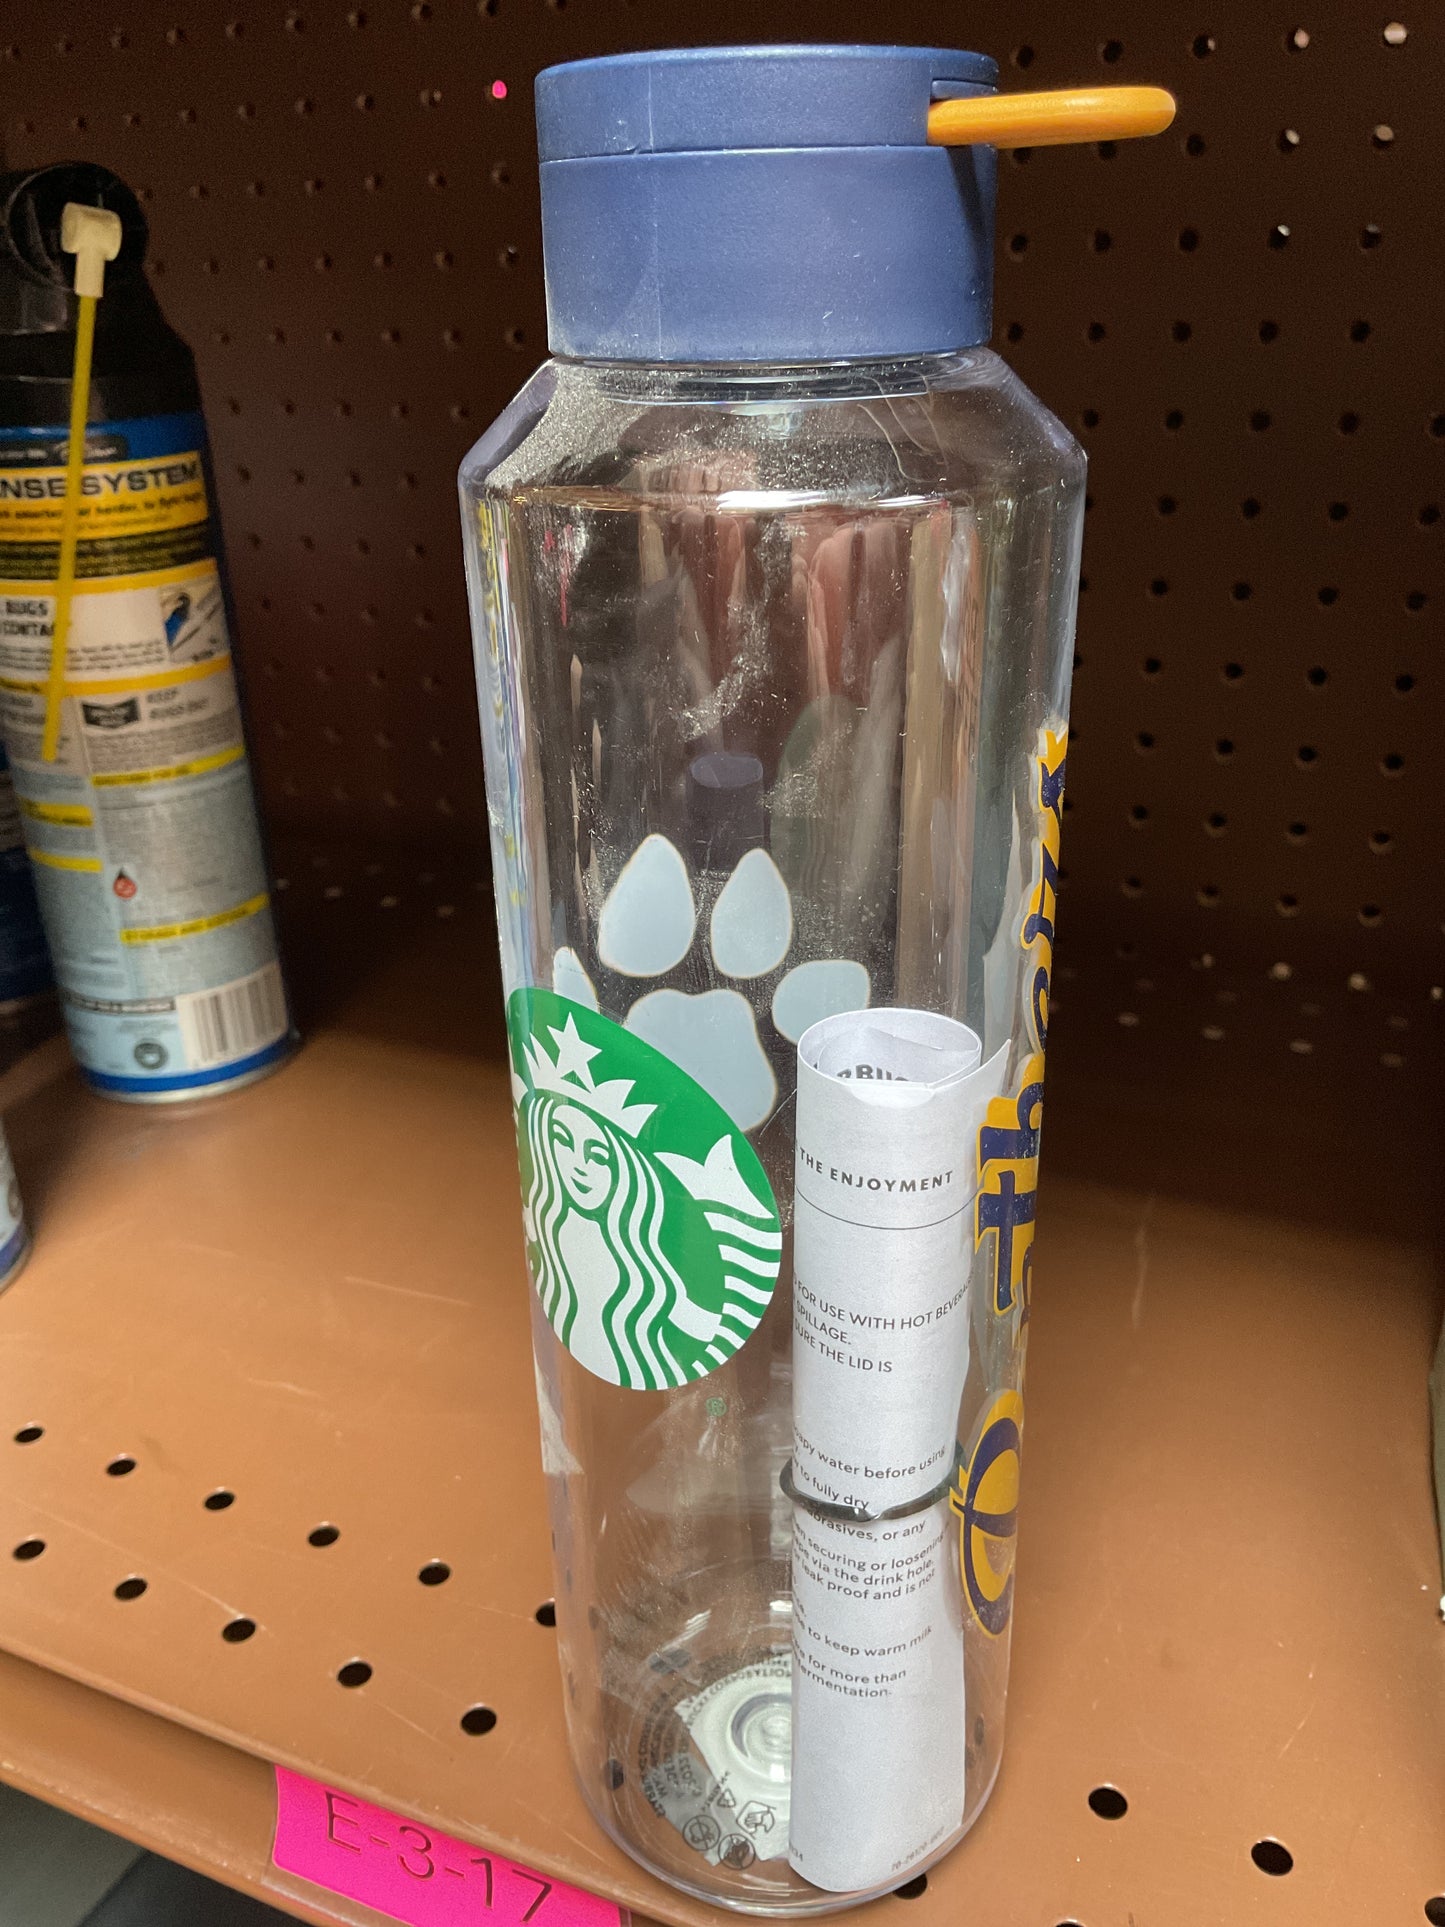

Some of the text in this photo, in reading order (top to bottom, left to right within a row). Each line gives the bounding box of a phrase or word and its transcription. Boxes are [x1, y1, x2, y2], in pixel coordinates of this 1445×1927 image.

[81, 459, 199, 496] SYSTEM
[800, 1147, 954, 1193] THE ENJOYMENT
[796, 1299, 852, 1346] SPILLAGE.
[797, 1280, 816, 1307] FOR
[819, 1299, 846, 1322] USE
[849, 1311, 896, 1331] WITH
[900, 1311, 933, 1331] HOT
[818, 1341, 845, 1365] THE
[848, 1355, 874, 1371] LID
[878, 1360, 893, 1373] IS
[818, 1451, 861, 1475] water
[864, 1464, 916, 1479] before
[919, 1445, 946, 1471] using
[812, 1476, 840, 1502] fully
[843, 1495, 870, 1511] dry
[882, 1530, 898, 1541] or
[902, 1519, 926, 1538] any
[808, 1537, 867, 1572] securing
[870, 1560, 886, 1571] or
[891, 1532, 945, 1570] loosening
[801, 1559, 937, 1600] leak proof and is not
[811, 1555, 934, 1586] via the drink hole.
[808, 1626, 821, 1641] to
[824, 1634, 860, 1657] keep
[864, 1643, 906, 1657] warm
[909, 1625, 932, 1647] milk
[808, 1654, 826, 1671] for
[830, 1668, 870, 1685] more
[874, 1669, 907, 1684] than
[324, 1790, 553, 1925] E-3-17
